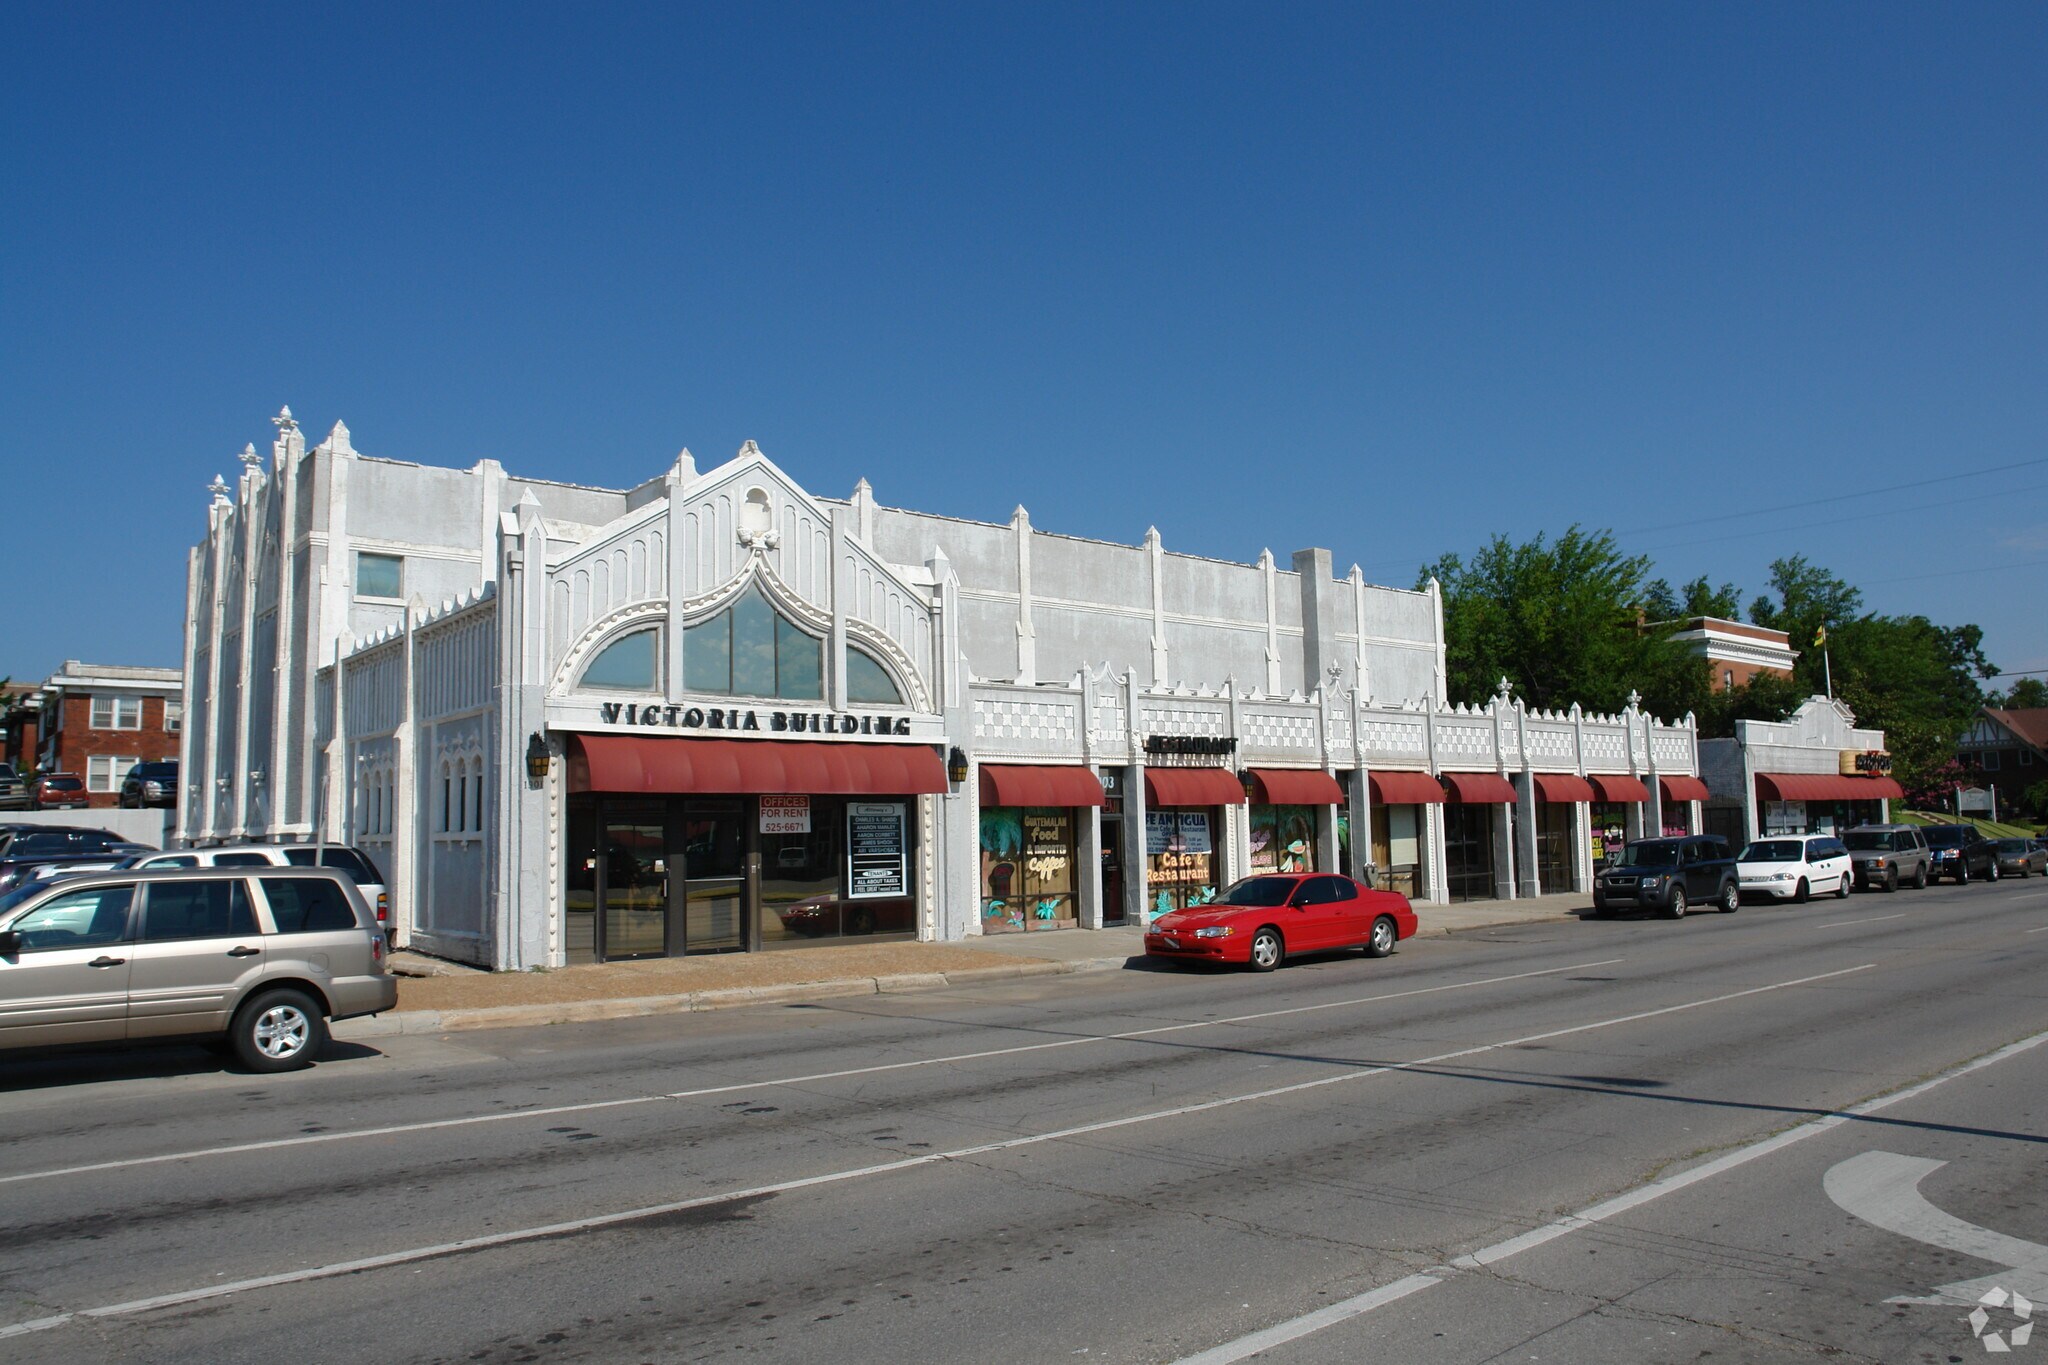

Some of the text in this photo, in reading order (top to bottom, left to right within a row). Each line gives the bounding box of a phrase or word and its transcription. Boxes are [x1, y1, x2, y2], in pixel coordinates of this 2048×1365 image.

[601, 702, 910, 735] VICTORIA BUILDING
[1149, 735, 1239, 754] RESTAURANT
[764, 797, 806, 806] OFFICES
[761, 808, 809, 818] FOR RENT
[1146, 813, 1206, 826] FE ANIGUA
[765, 822, 804, 832] 525-6671
[1024, 815, 1067, 827] GUATEMALAN
[1031, 827, 1059, 842] food
[1027, 844, 1067, 855] & IMPORTED
[1162, 852, 1204, 866] Cafe &
[1028, 856, 1066, 880] Coffee
[1147, 867, 1209, 882] Restaurant
